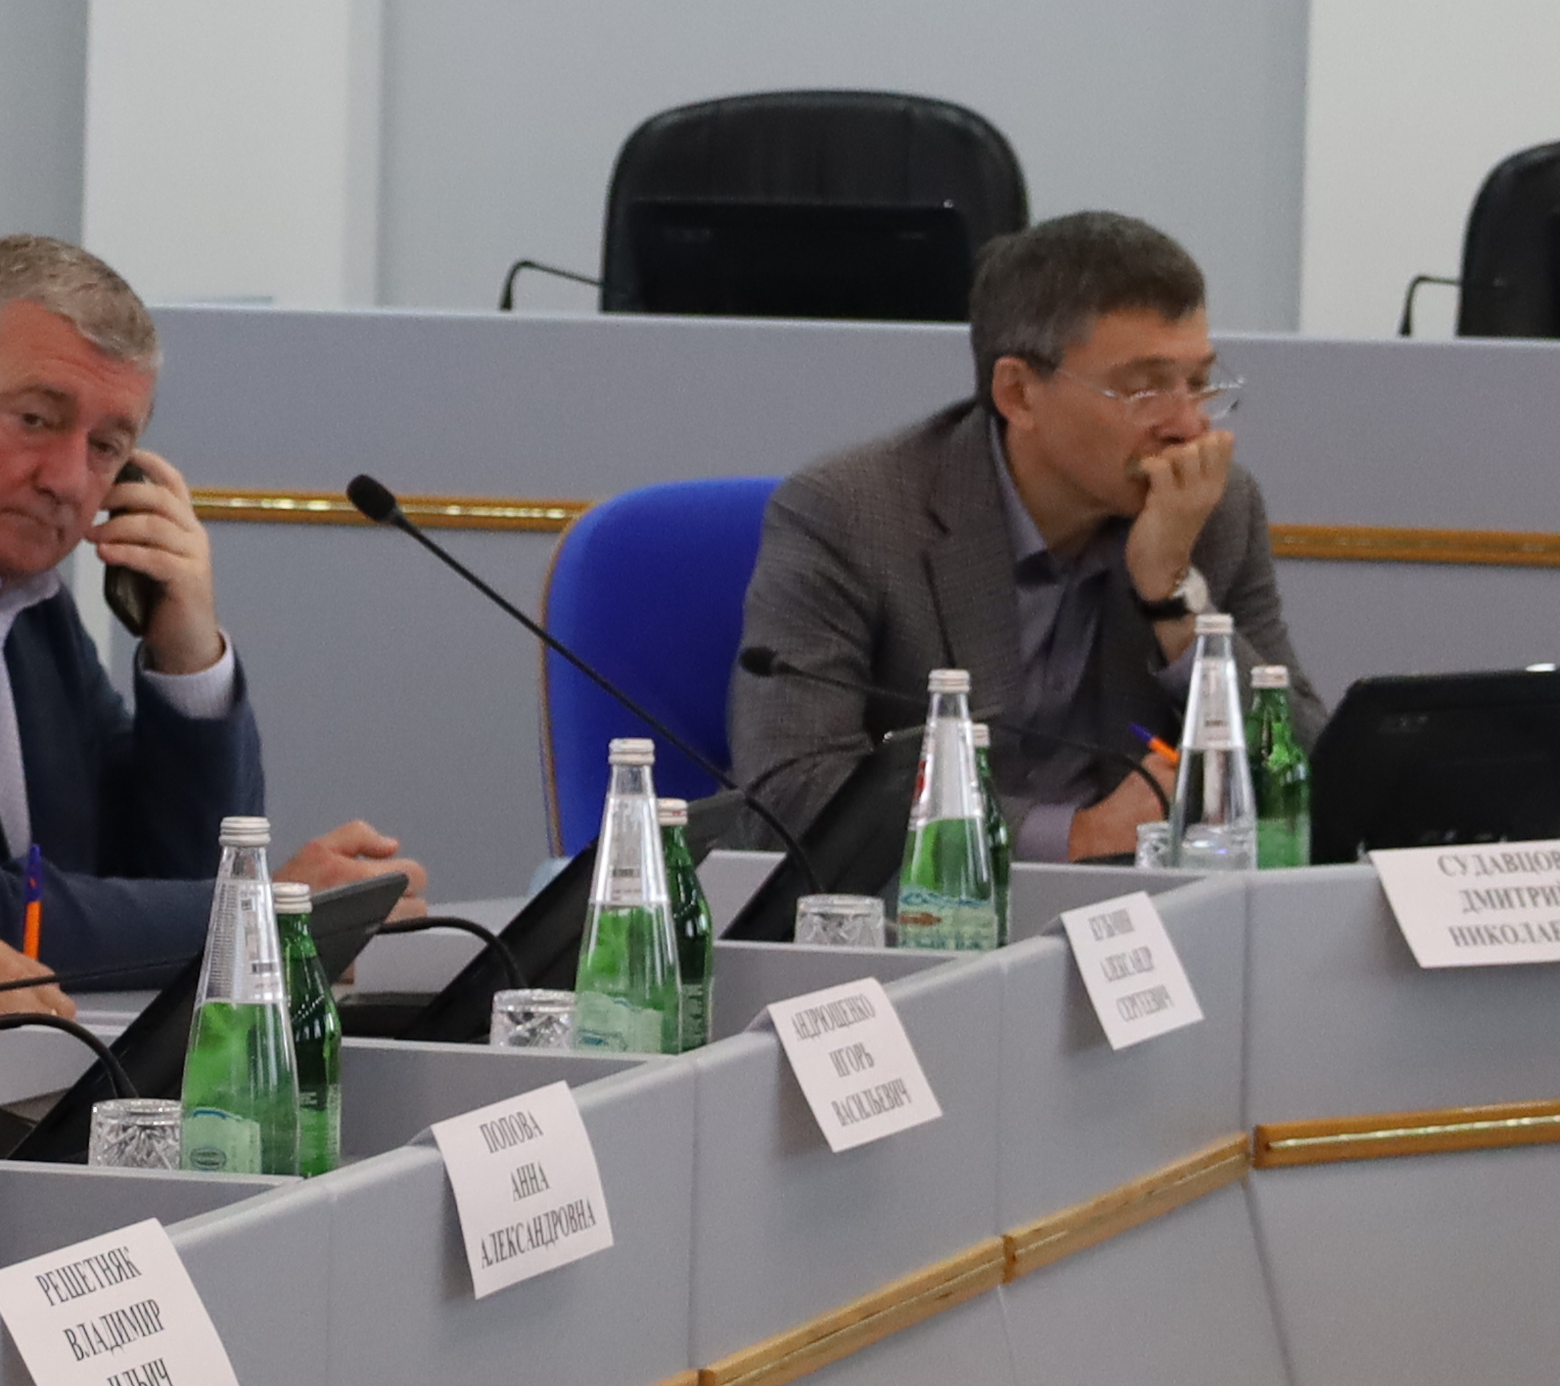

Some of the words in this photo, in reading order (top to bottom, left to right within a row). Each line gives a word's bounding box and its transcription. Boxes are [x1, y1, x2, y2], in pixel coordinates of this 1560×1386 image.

[791, 993, 877, 1042] АНДРЮЩЕНКО
[828, 1041, 876, 1078] ИГОРЬ
[831, 1078, 913, 1127] ВАСИЛЬЕВИЧ
[479, 1110, 544, 1154] ПОПОВА
[510, 1160, 551, 1203] АННА
[480, 1197, 597, 1270] АЛЕКСАНДРОВНА
[35, 1245, 143, 1307] РЕШЕТНЯК
[63, 1299, 166, 1363] ВЛАДИМИР
